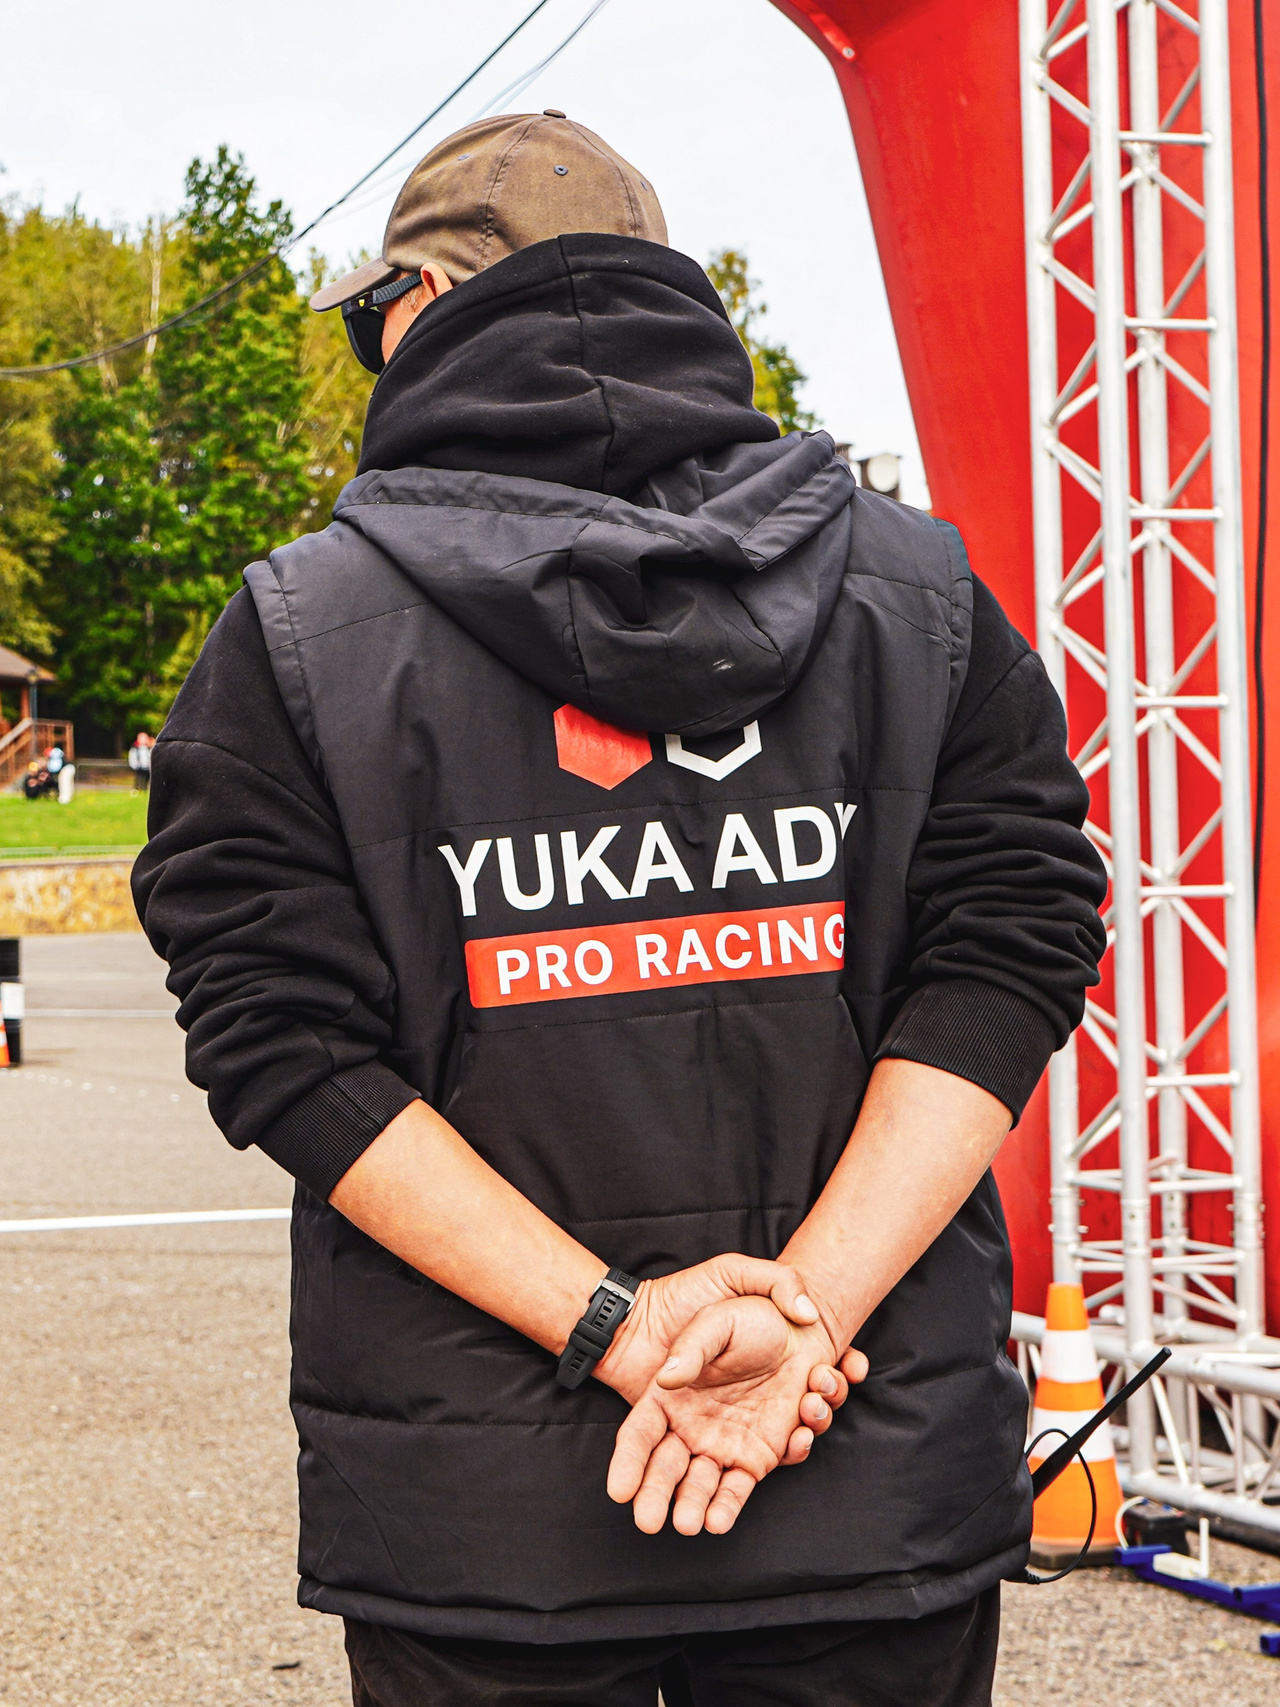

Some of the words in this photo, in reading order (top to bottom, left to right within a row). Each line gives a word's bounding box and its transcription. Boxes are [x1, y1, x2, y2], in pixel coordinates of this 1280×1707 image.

[437, 821, 694, 917] YUKA
[495, 939, 614, 995] PRO
[635, 913, 845, 980] RACING
